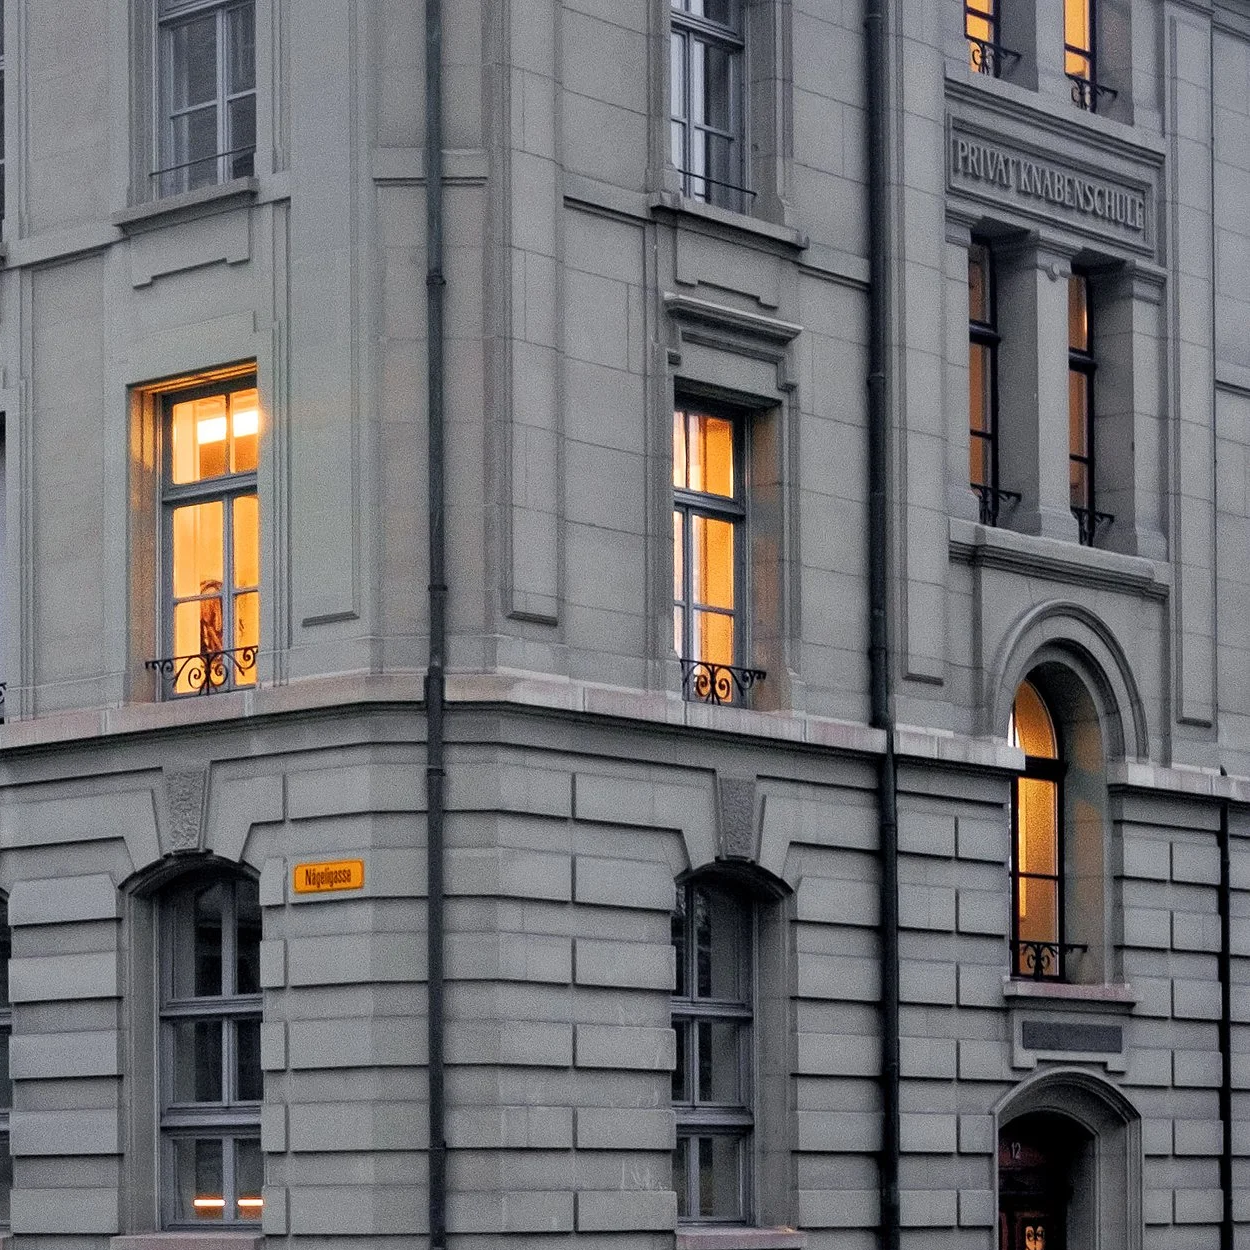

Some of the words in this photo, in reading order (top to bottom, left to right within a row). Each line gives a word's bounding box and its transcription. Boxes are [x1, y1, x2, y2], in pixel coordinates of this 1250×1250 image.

[958, 141, 1016, 187] PRIVAT
[1021, 161, 1144, 228] KNABENSCHULE
[305, 868, 351, 887] Nägeligasse
[1011, 1142, 1021, 1160] 12
